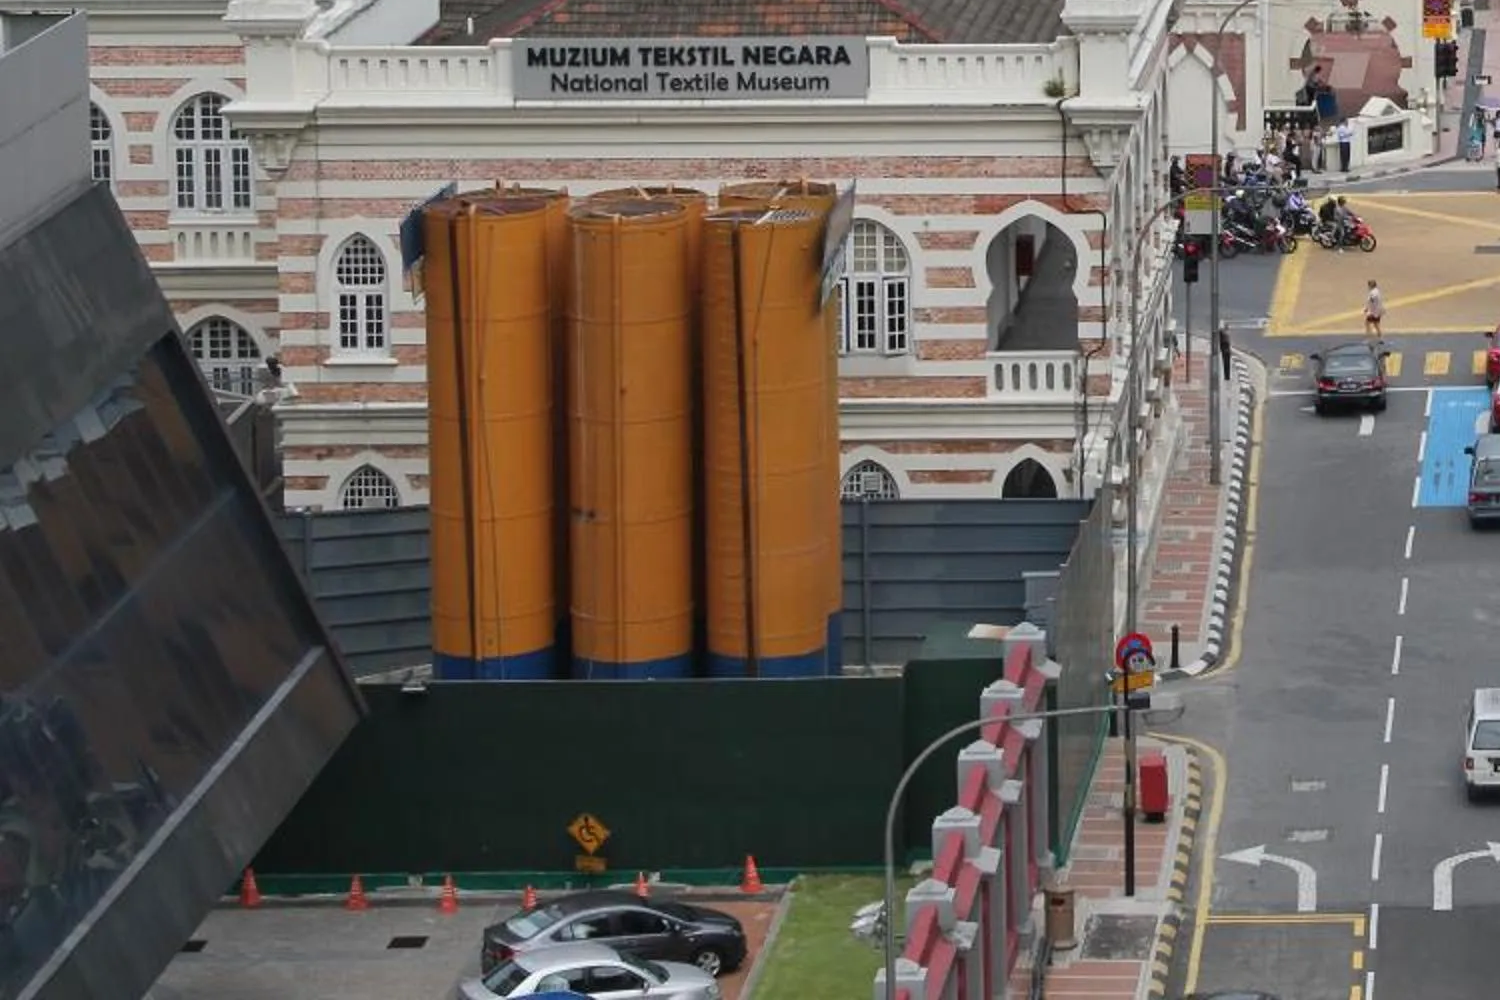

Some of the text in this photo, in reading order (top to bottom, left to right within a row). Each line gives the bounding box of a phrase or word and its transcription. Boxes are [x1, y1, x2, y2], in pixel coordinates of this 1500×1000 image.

[526, 45, 852, 67] MUZIUM TEKSTIL NEGARA
[550, 71, 830, 94] National Textile Museum
